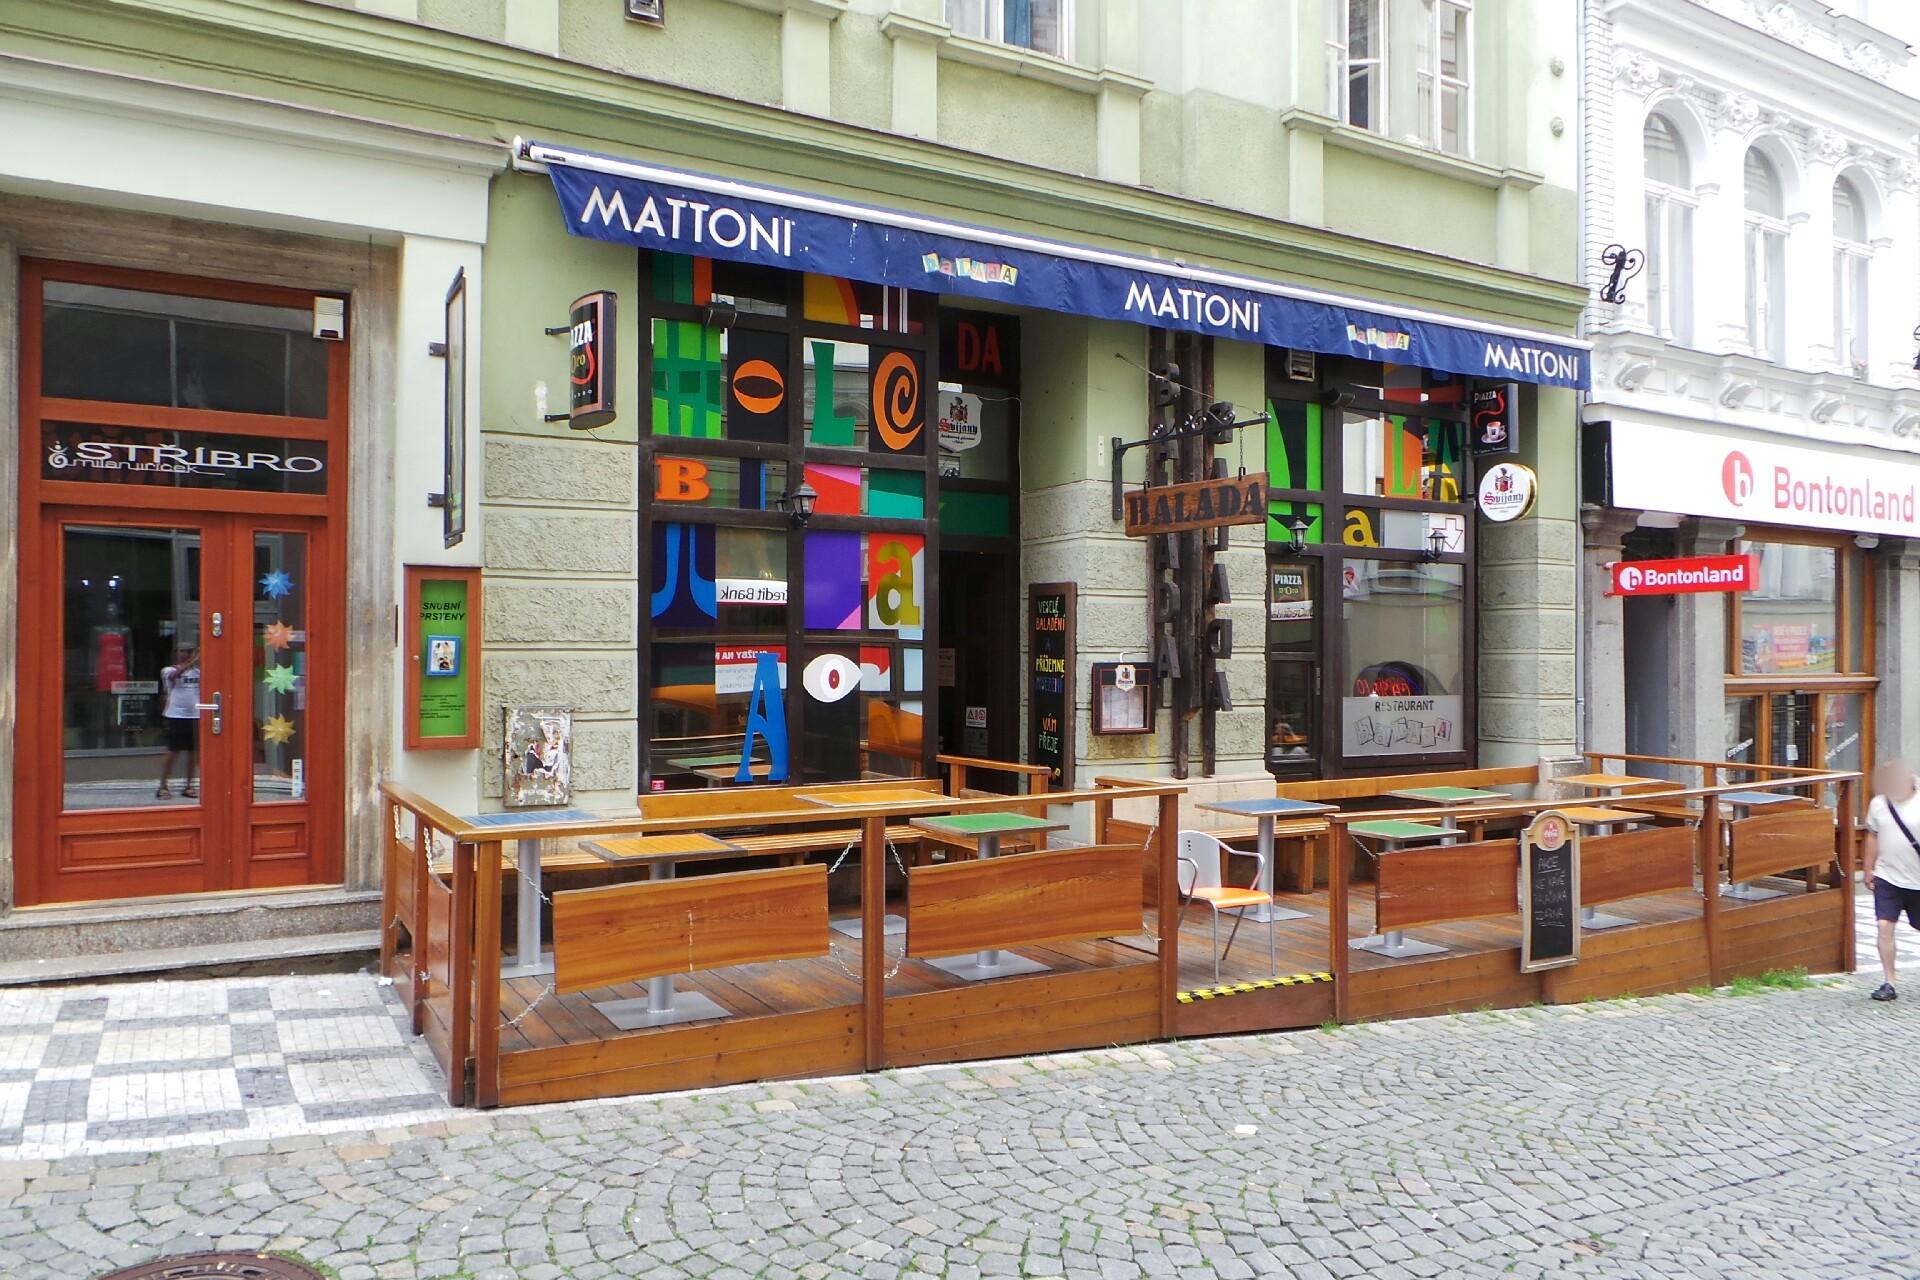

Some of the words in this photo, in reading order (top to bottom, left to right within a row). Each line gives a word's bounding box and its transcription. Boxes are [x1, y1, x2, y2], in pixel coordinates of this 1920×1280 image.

[580, 185, 794, 257] MATTONI
[1124, 280, 1260, 333] MATTONI
[1484, 342, 1578, 382] MATTONI
[76, 442, 323, 473] STŘÍBRO
[1130, 482, 1265, 526] BALADA
[1774, 465, 1915, 524] Bontonland
[1274, 573, 1302, 585] PIAZZA
[1645, 564, 1744, 586] Bontonland
[423, 601, 461, 611] SNUBNÍ
[1375, 700, 1434, 712] RESTAURANT
